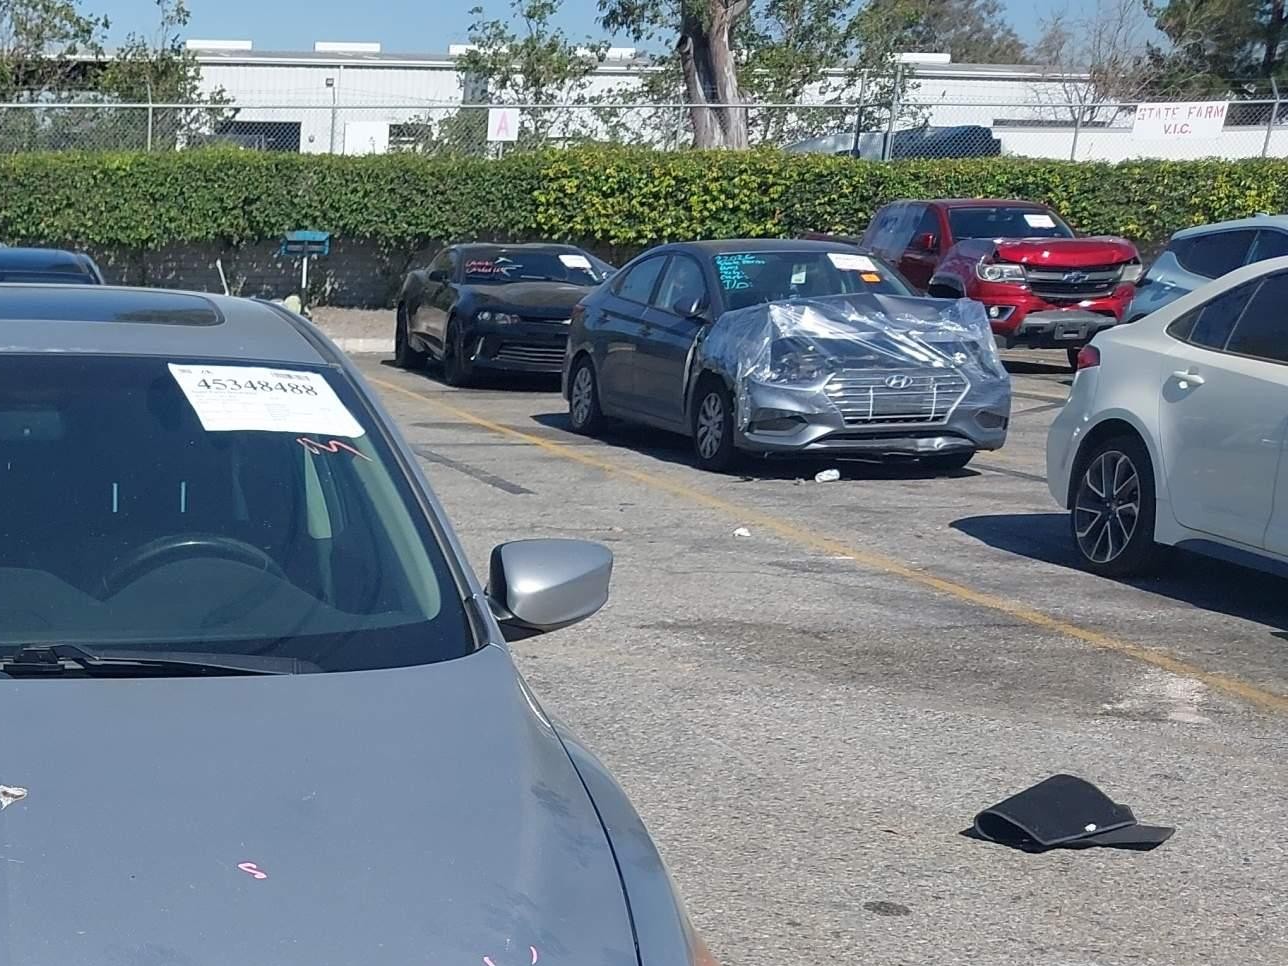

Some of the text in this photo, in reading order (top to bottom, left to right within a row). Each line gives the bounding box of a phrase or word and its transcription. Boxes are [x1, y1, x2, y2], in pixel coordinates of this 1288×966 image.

[1137, 105, 1225, 121] STATE FARM
[496, 111, 510, 137] A
[1163, 123, 1192, 135] V.I.C.
[196, 378, 319, 397] 45348488
